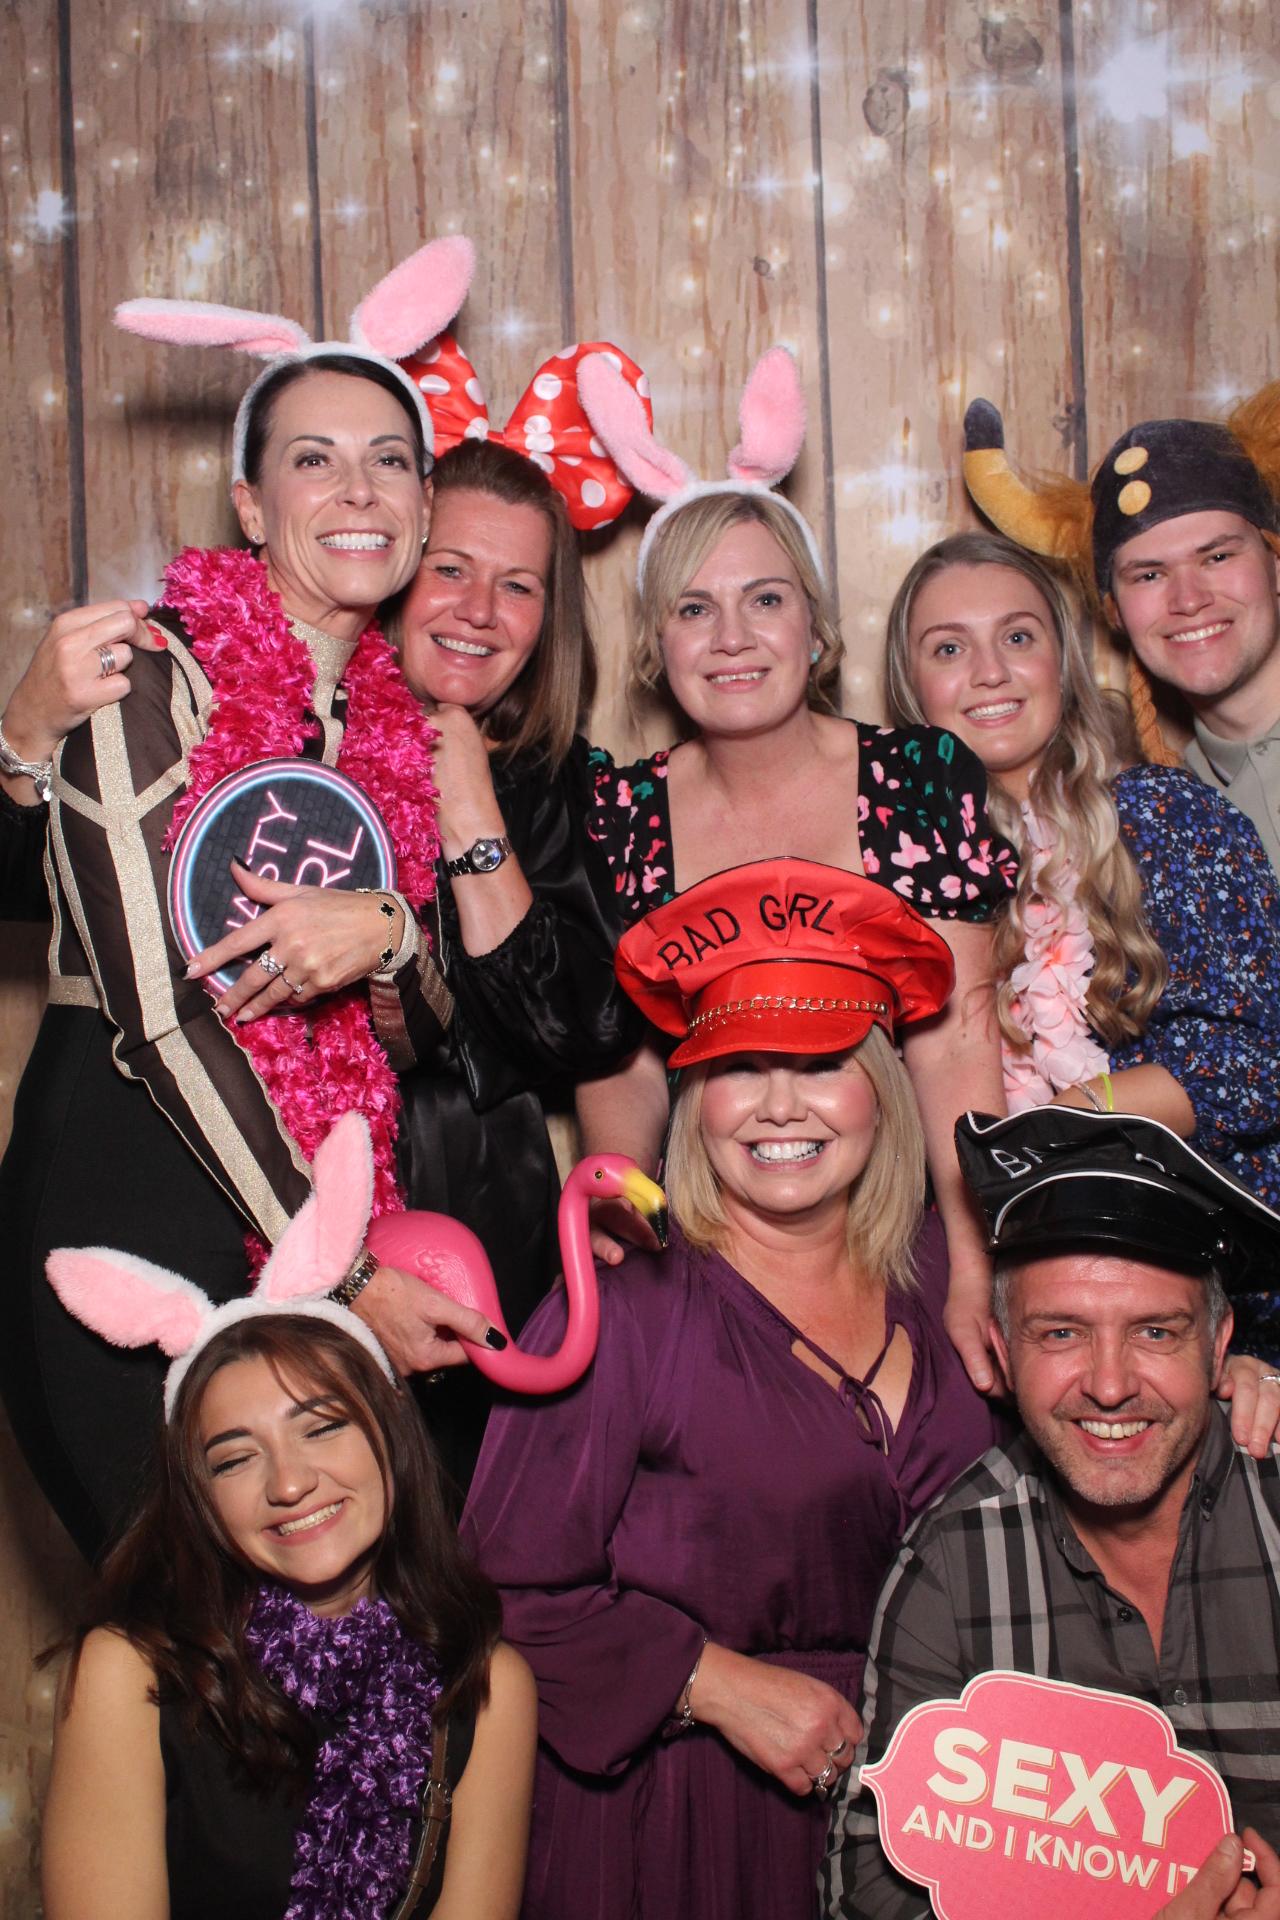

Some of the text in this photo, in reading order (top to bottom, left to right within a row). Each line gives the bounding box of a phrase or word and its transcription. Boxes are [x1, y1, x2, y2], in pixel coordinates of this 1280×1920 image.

[656, 906, 741, 971] BAD
[926, 1727, 1199, 1849] SEXY
[901, 1804, 996, 1852] AND
[1004, 1826, 1017, 1859] I
[1025, 1830, 1160, 1890] KNOW
